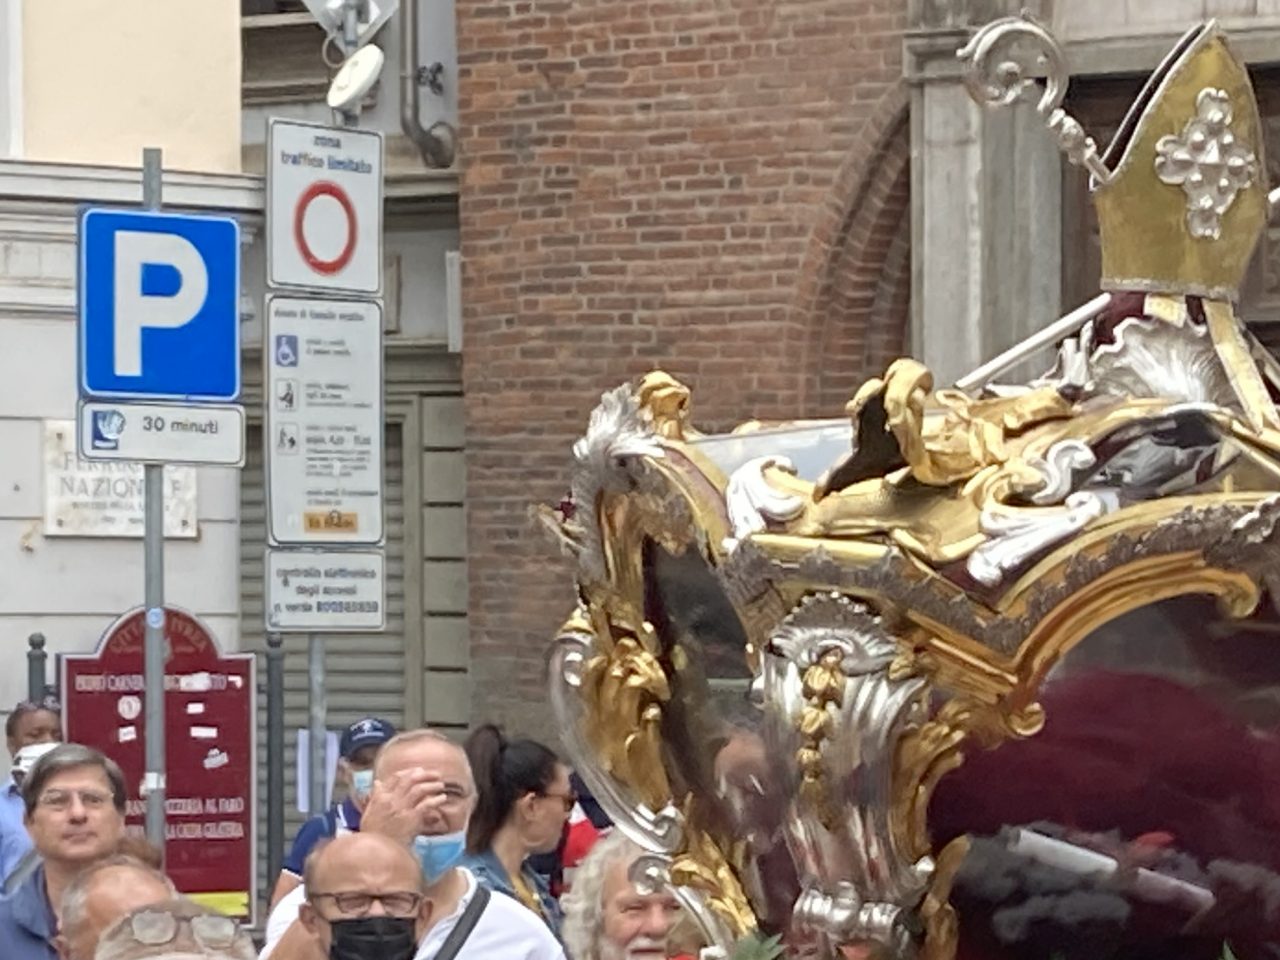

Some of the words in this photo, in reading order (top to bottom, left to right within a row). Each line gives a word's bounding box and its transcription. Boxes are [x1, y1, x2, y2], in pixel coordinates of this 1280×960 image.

[281, 150, 325, 168] traffico
[327, 154, 372, 174] limitato
[114, 229, 208, 377] P
[142, 415, 165, 432] 30
[170, 418, 219, 434] minuti
